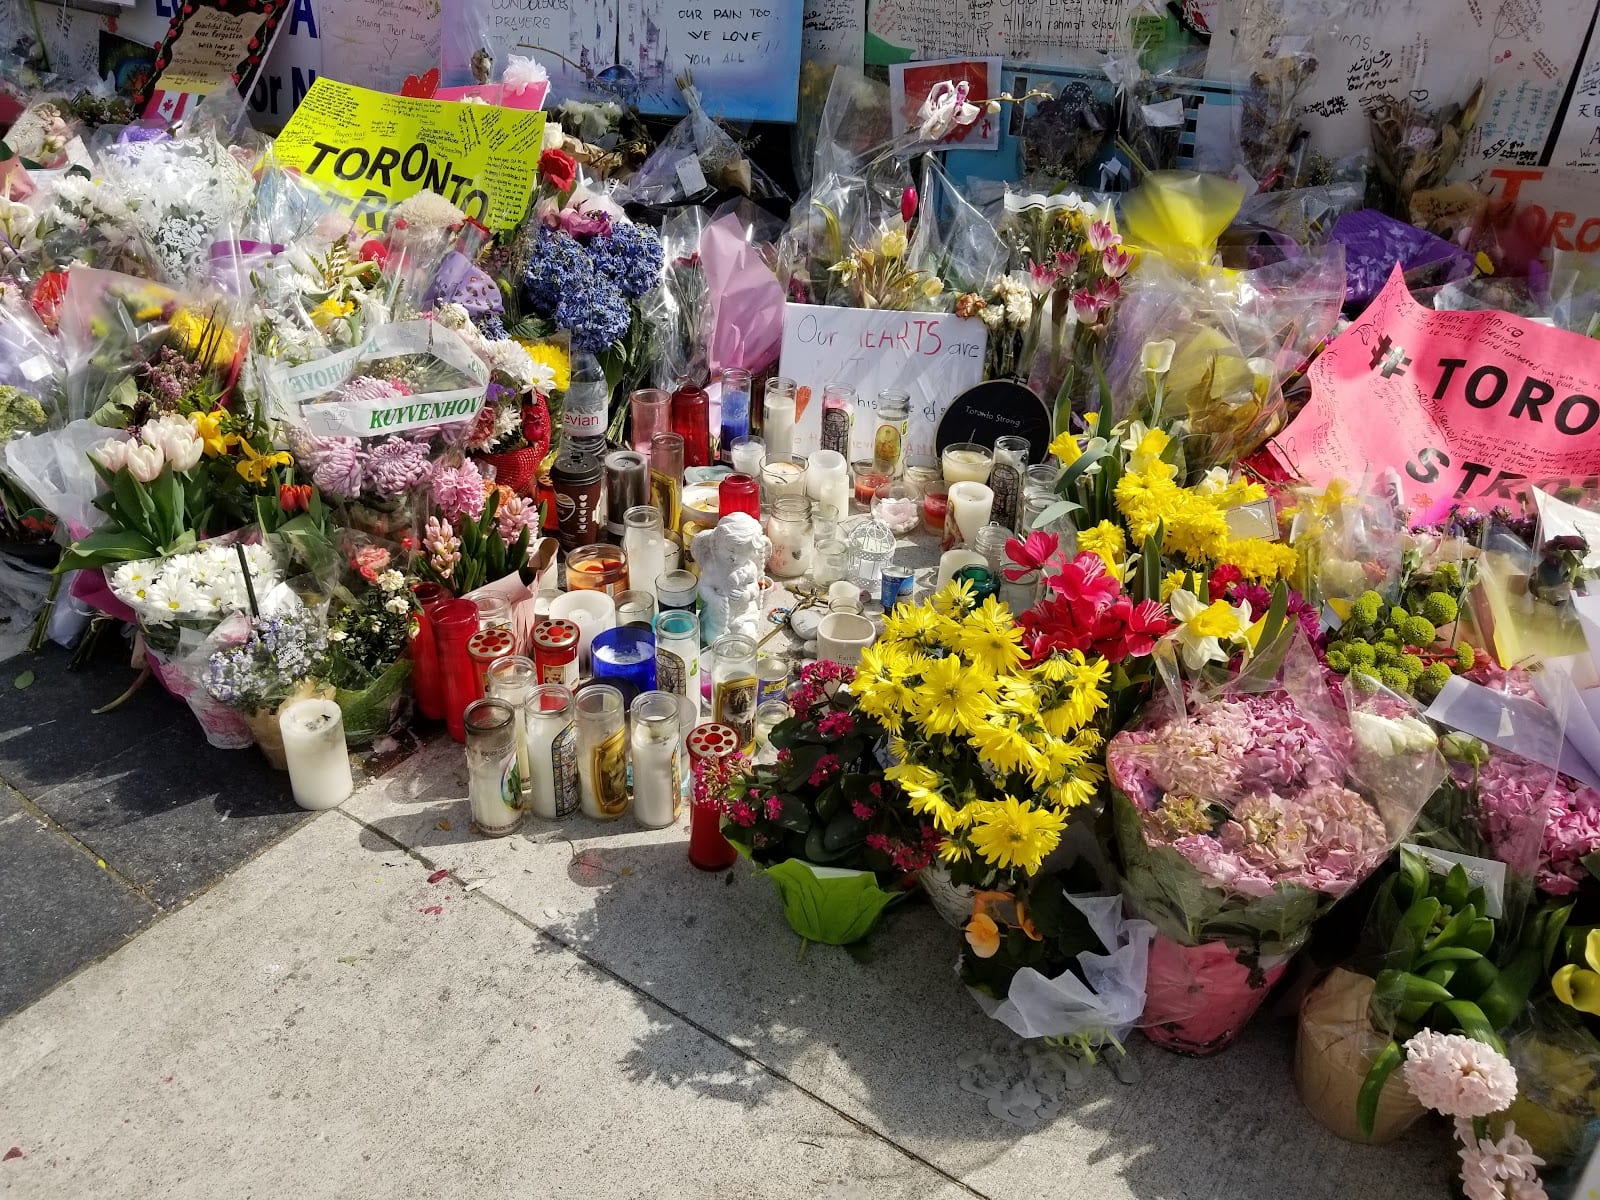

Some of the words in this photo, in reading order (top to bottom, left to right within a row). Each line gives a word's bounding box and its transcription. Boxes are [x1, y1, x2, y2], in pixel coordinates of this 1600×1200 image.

[678, 9, 702, 20] OUR
[714, 9, 742, 19] PAIN
[1004, 14, 1042, 30] Allah
[496, 16, 551, 29] PRAYERS
[688, 30, 712, 40] WE
[722, 31, 762, 42] LOVE
[685, 54, 710, 66] YOU
[722, 52, 745, 63] ALL
[304, 141, 488, 224] TORONTO
[798, 314, 837, 346] Our
[948, 342, 980, 358] are
[369, 395, 483, 429] KUYVENHOV
[563, 413, 599, 424] evian
[966, 406, 994, 420] Toronto
[996, 414, 1020, 428] Strong
